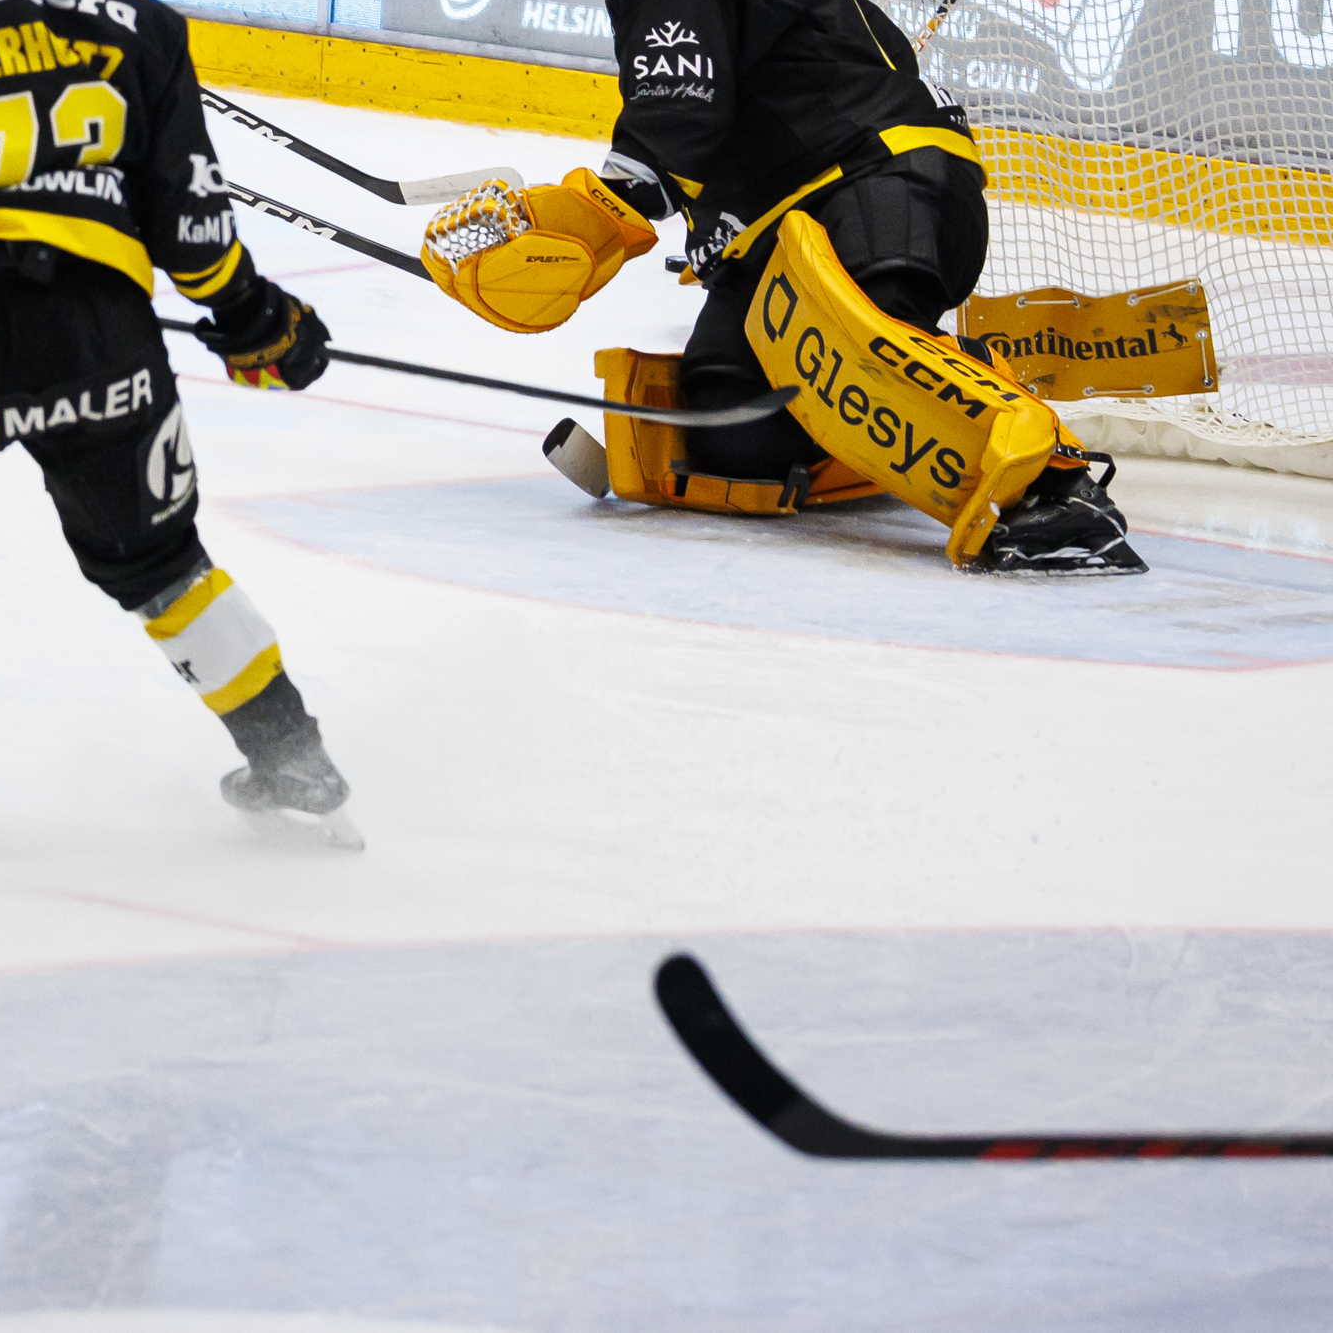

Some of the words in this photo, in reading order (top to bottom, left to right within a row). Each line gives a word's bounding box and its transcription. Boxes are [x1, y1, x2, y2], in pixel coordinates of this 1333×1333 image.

[633, 54, 714, 81] SANI
[591, 188, 627, 219] CCM
[868, 336, 989, 421] CCM
[908, 334, 1023, 403] CCM
[976, 325, 1161, 363] Continental
[2, 368, 153, 438] MALER
[794, 326, 967, 490] Glesys
